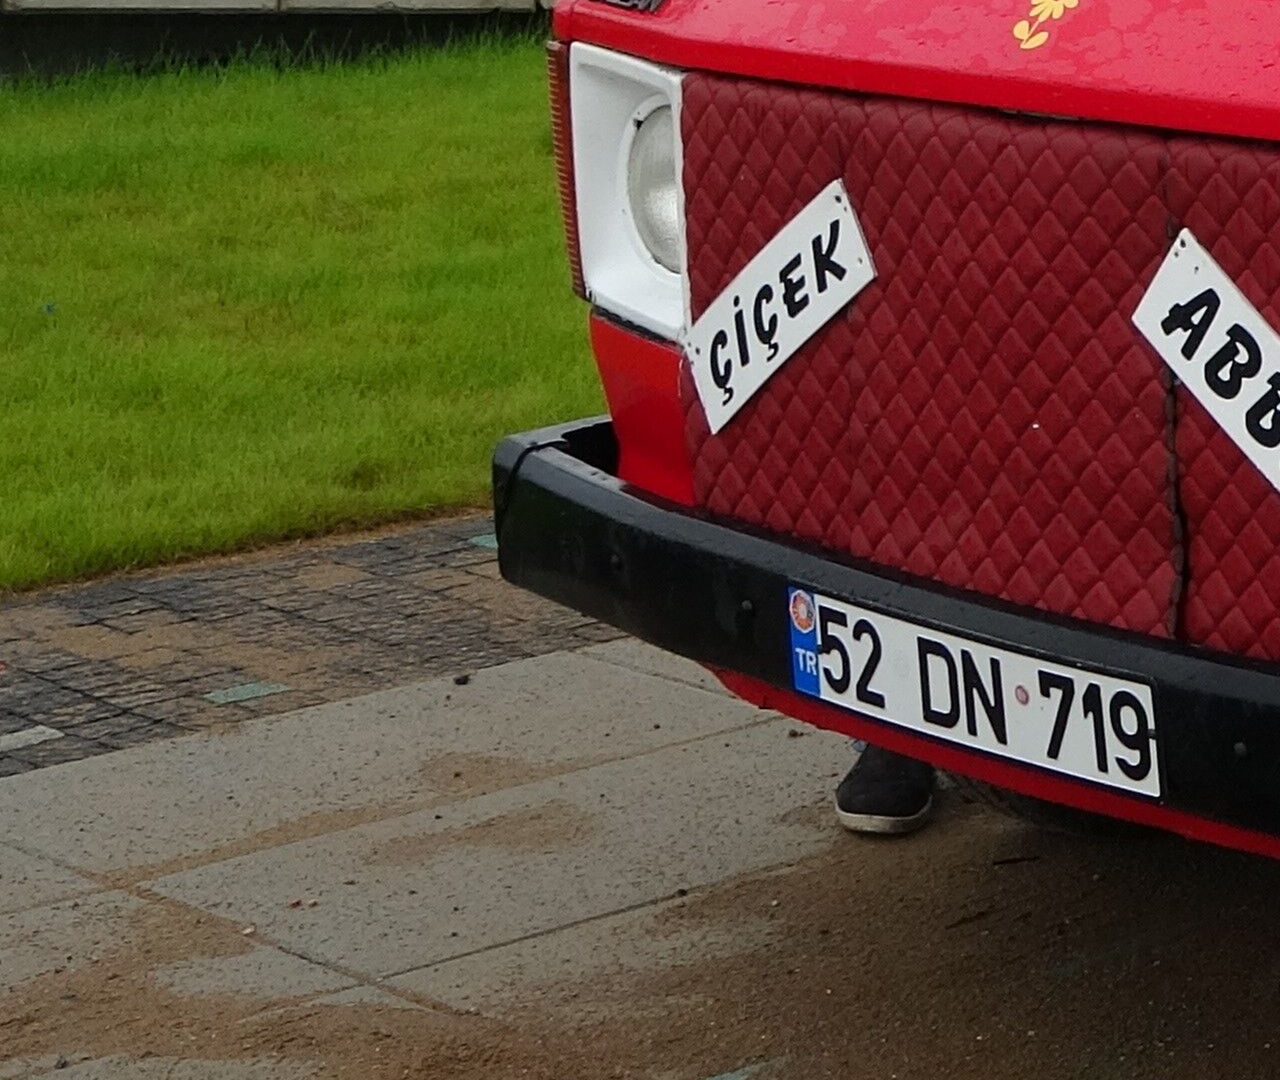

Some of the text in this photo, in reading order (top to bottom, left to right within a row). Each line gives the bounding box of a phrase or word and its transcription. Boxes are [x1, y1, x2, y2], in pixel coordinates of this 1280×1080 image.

[709, 219, 847, 406] ÇİÇEK
[795, 647, 817, 676] TR
[818, 604, 1152, 781] 52 DN 719
